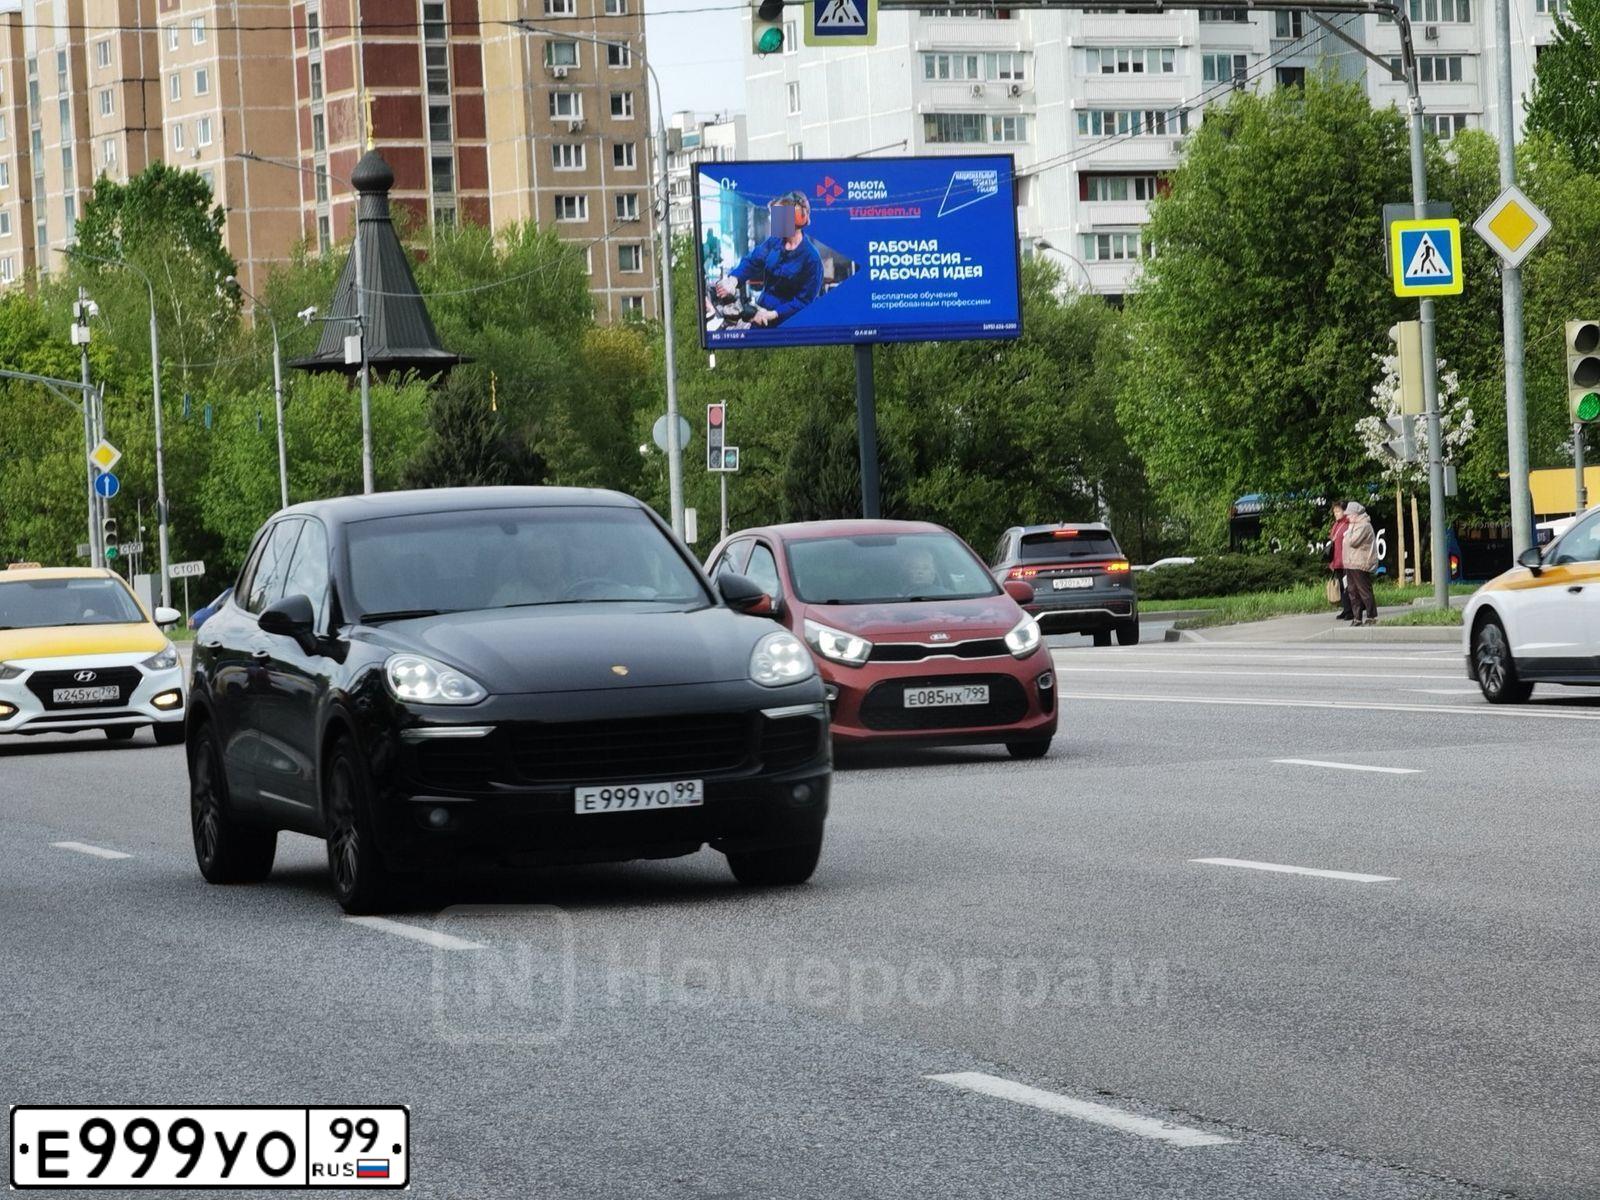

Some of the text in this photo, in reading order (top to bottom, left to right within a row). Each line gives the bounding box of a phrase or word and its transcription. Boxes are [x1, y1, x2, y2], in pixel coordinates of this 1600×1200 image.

[721, 177, 738, 190] 0+
[848, 181, 885, 190] РАБОТА
[848, 190, 887, 199] РОССИИ
[869, 240, 938, 253] РАБОЧАЯ
[869, 253, 961, 267] ПРОФЕССИЯ
[870, 265, 982, 280] РАБОЧАЯ ИДЕЯ
[871, 291, 958, 303] Бесплатное обучение
[173, 563, 200, 575] СТОП
[908, 687, 985, 706] Е085НХ 799
[584, 782, 695, 810] Е999УО 99
